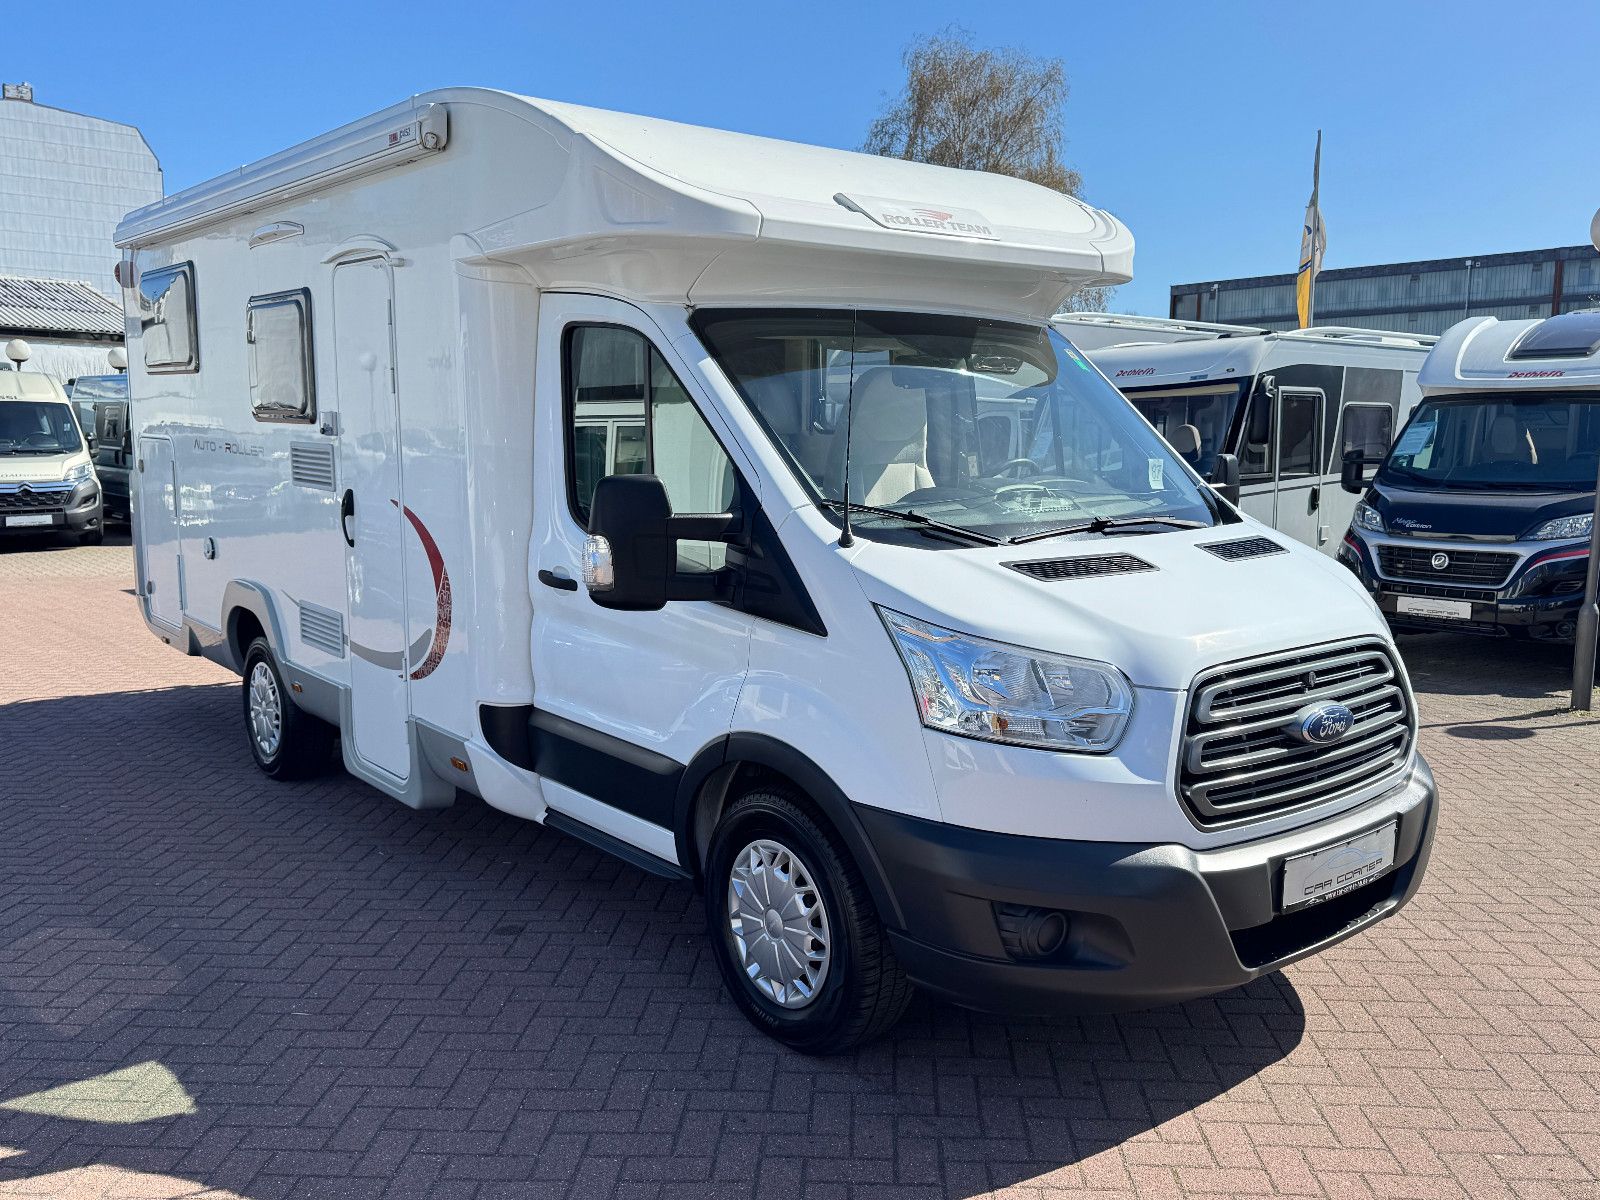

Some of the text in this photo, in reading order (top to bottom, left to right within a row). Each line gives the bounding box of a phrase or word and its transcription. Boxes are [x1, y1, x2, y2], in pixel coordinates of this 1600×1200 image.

[882, 213, 992, 235] ROLLER TEAM
[193, 439, 217, 452] AUTO
[225, 442, 265, 457] ROLLER
[1320, 711, 1346, 737] Ford
[1304, 879, 1333, 896] CAR
[1336, 857, 1383, 885] CORNER
